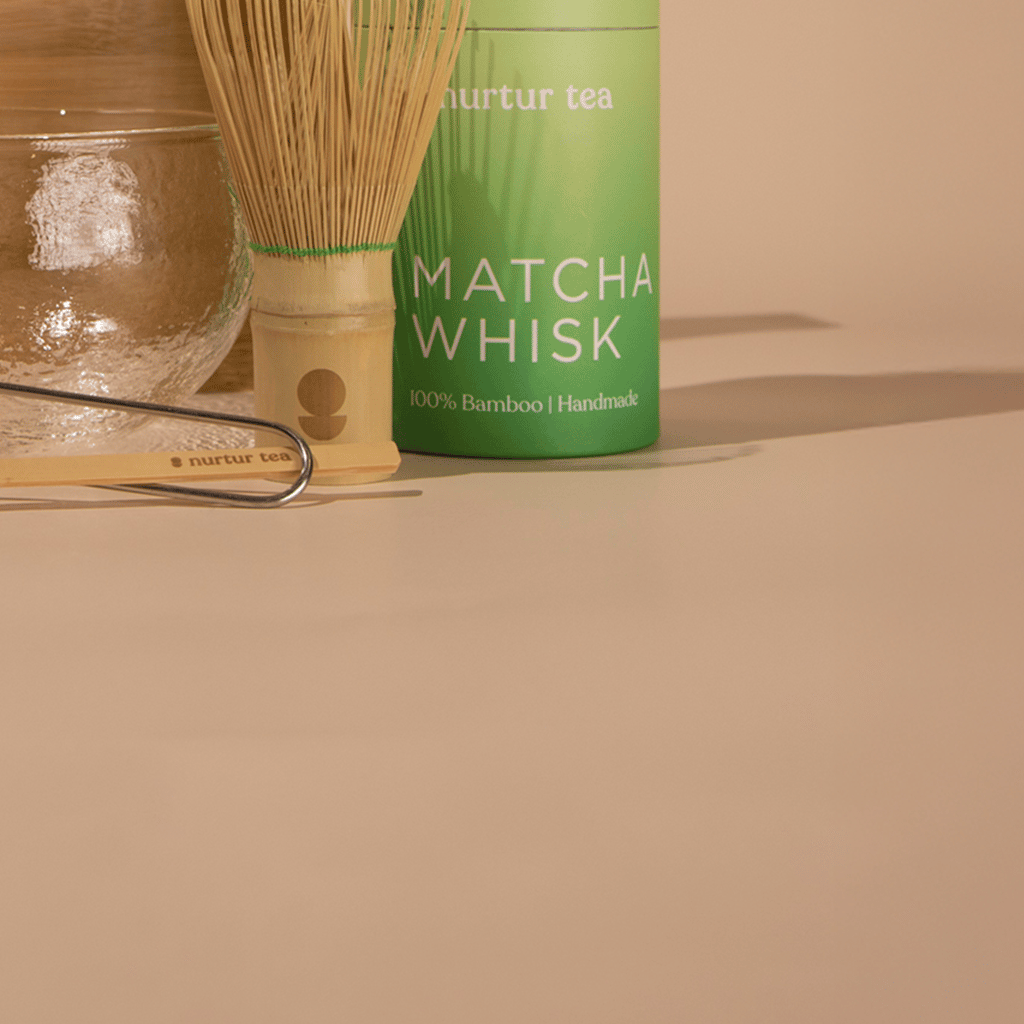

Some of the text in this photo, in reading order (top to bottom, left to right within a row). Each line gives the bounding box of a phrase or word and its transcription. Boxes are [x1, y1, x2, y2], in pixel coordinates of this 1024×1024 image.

[566, 84, 613, 110] tea
[413, 252, 653, 303] MATCHA
[412, 313, 622, 363] WHISK
[410, 389, 457, 410] 100%
[462, 394, 543, 413] Bamboo
[558, 389, 639, 413] Handmade
[189, 452, 292, 467] nurtur tea
